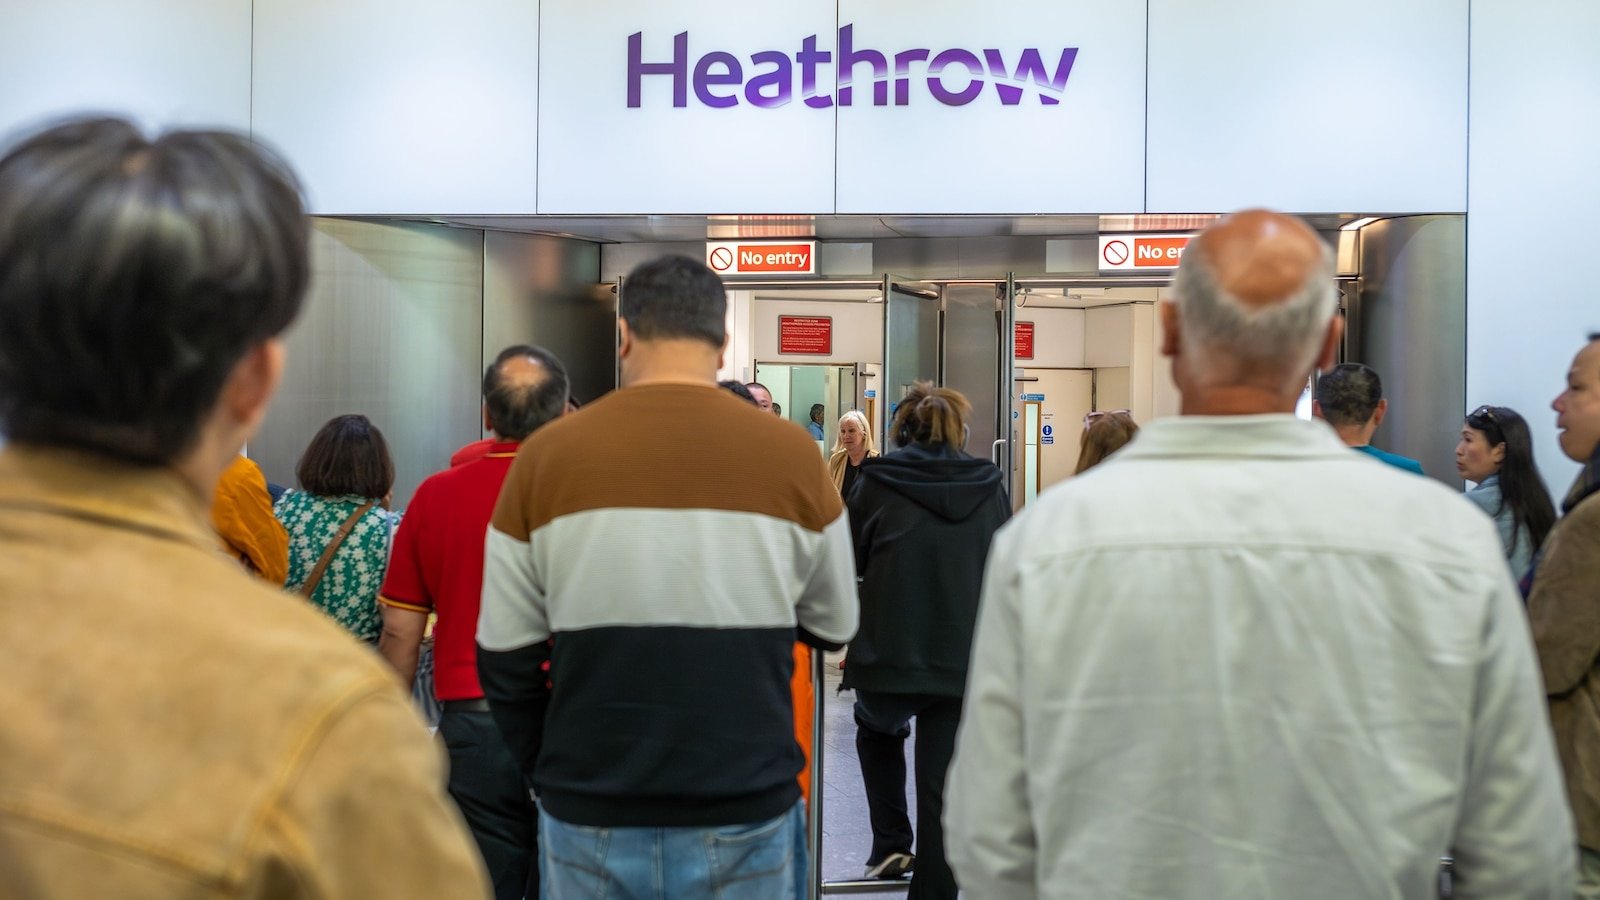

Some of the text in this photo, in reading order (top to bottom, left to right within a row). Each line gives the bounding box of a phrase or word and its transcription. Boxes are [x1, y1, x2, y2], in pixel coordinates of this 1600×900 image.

[627, 23, 1079, 108] Heathrow
[741, 251, 808, 268] No entry
[1138, 245, 1163, 259] No
